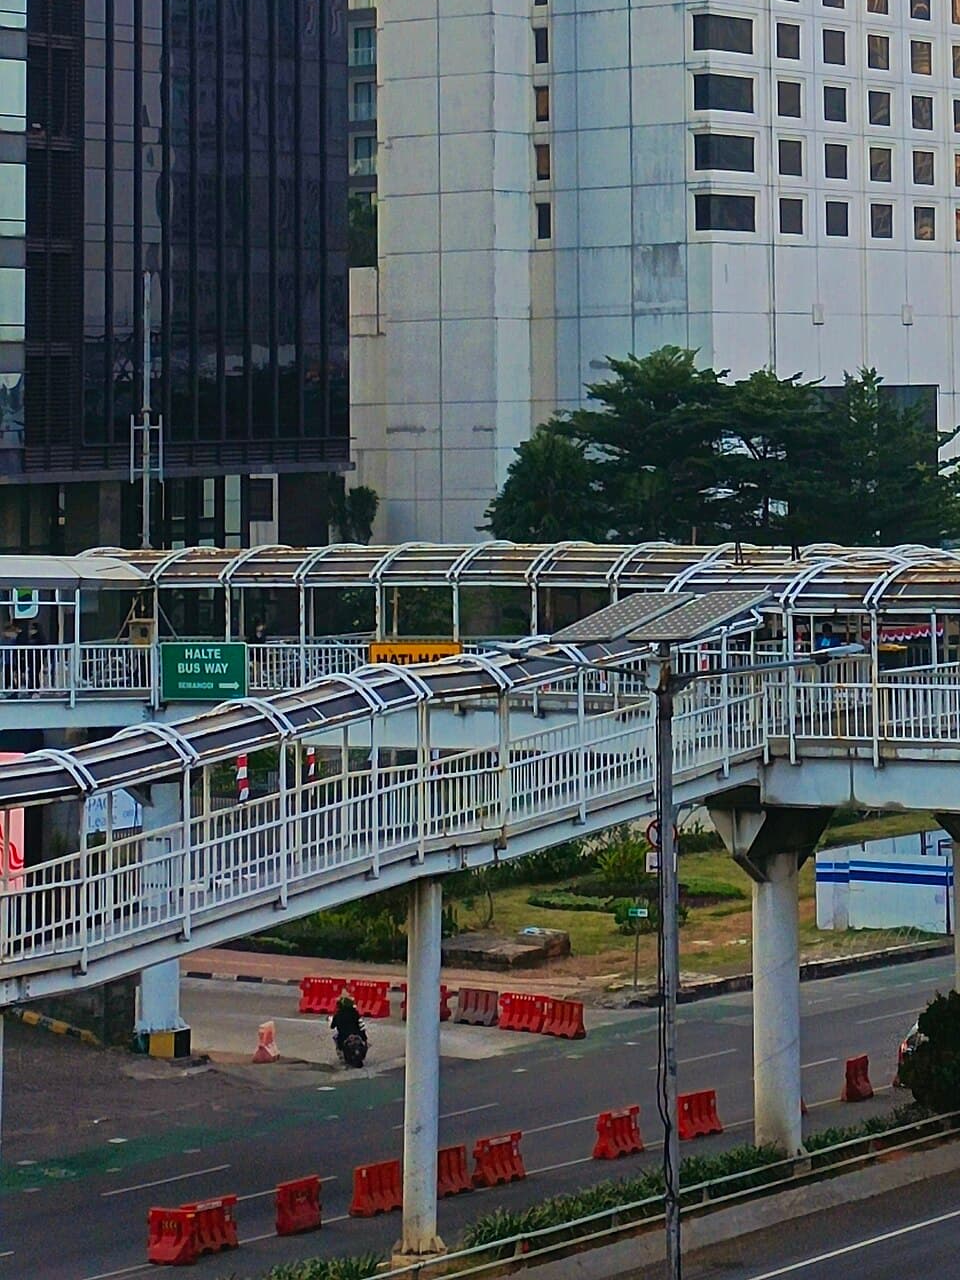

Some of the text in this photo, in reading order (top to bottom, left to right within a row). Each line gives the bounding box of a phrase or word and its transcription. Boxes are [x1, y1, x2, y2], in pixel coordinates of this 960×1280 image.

[184, 648, 221, 659] HALTE
[177, 663, 229, 674] BUS WAY
